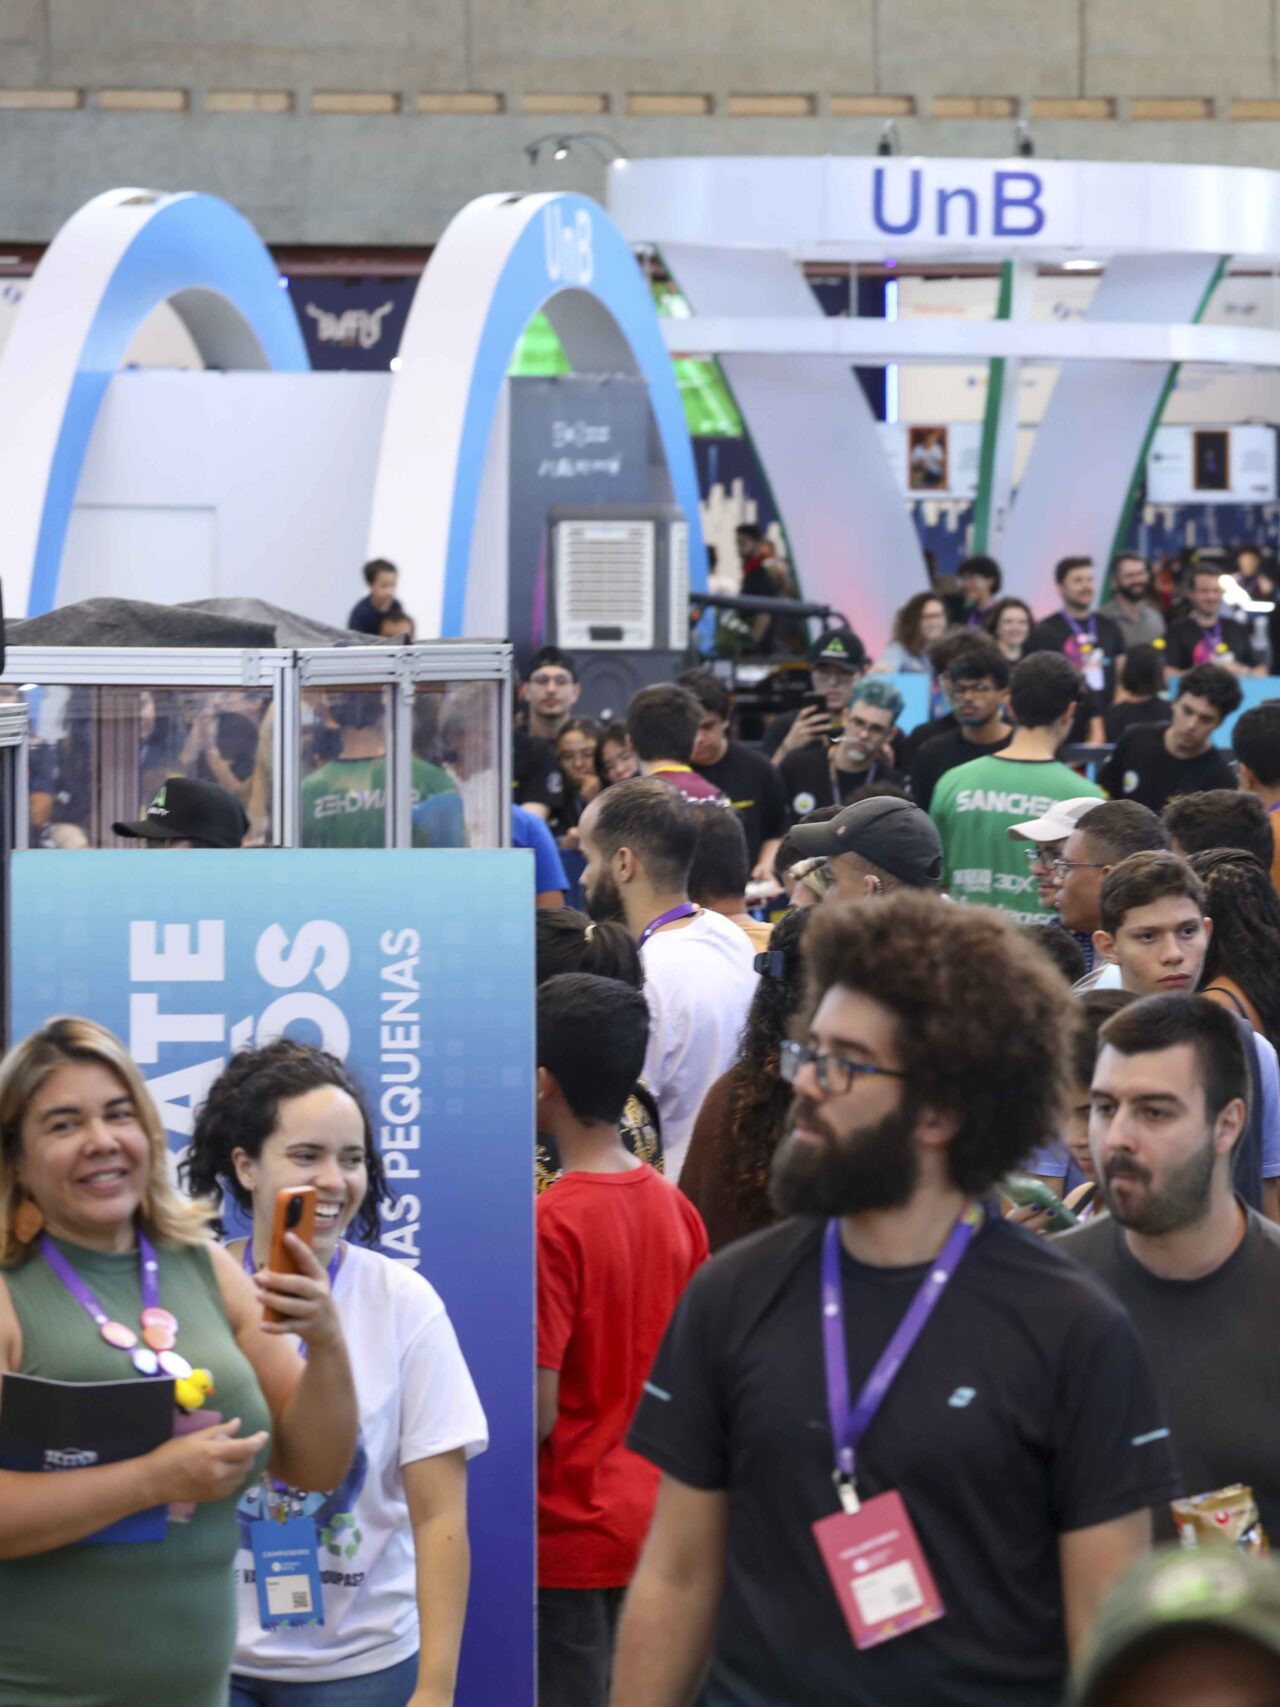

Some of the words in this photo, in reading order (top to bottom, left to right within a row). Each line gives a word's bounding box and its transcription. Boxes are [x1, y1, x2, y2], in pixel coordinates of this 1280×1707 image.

[873, 168, 1046, 236] UnB
[543, 204, 594, 286] UnB
[955, 789, 1058, 817] SANCHE
[379, 927, 422, 1179] PEQUENAS
